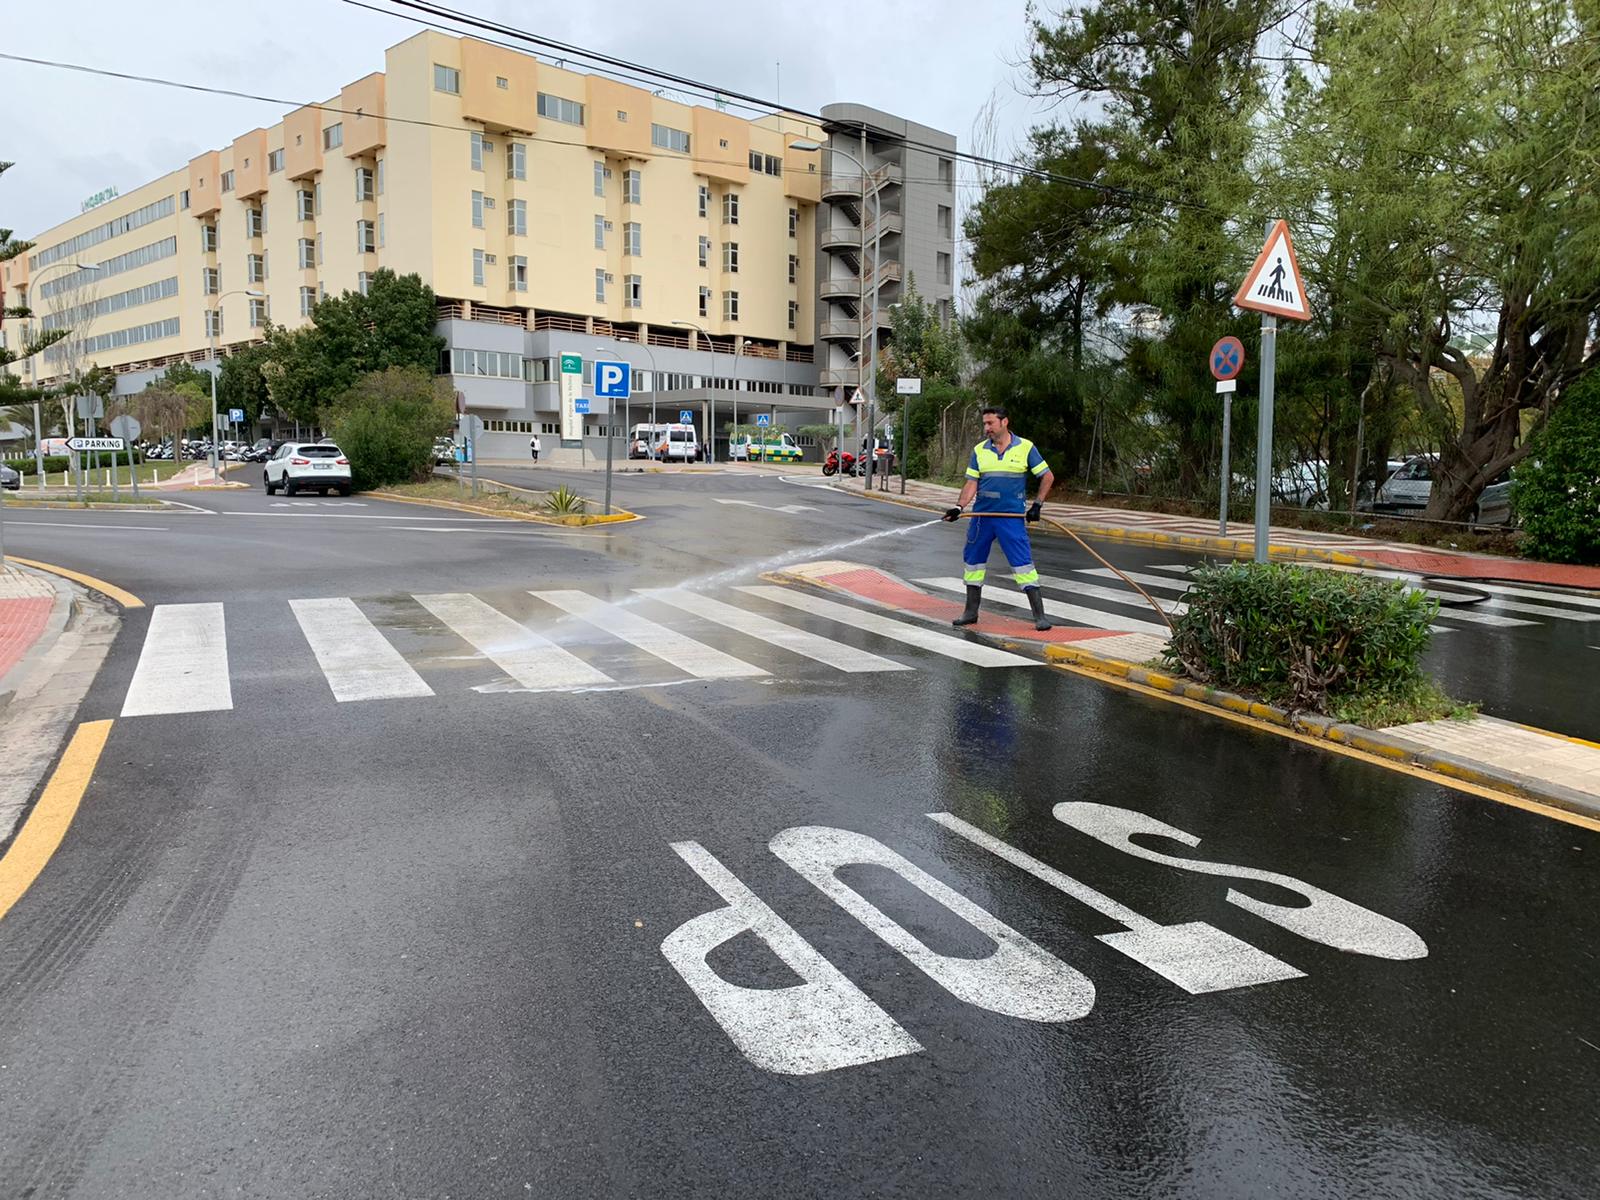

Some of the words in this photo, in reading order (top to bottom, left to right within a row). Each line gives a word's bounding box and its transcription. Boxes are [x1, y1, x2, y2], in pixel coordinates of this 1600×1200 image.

[602, 365, 623, 393] P
[232, 410, 240, 420] P
[84, 440, 120, 448] PARKING
[661, 801, 1428, 1075] STOP
